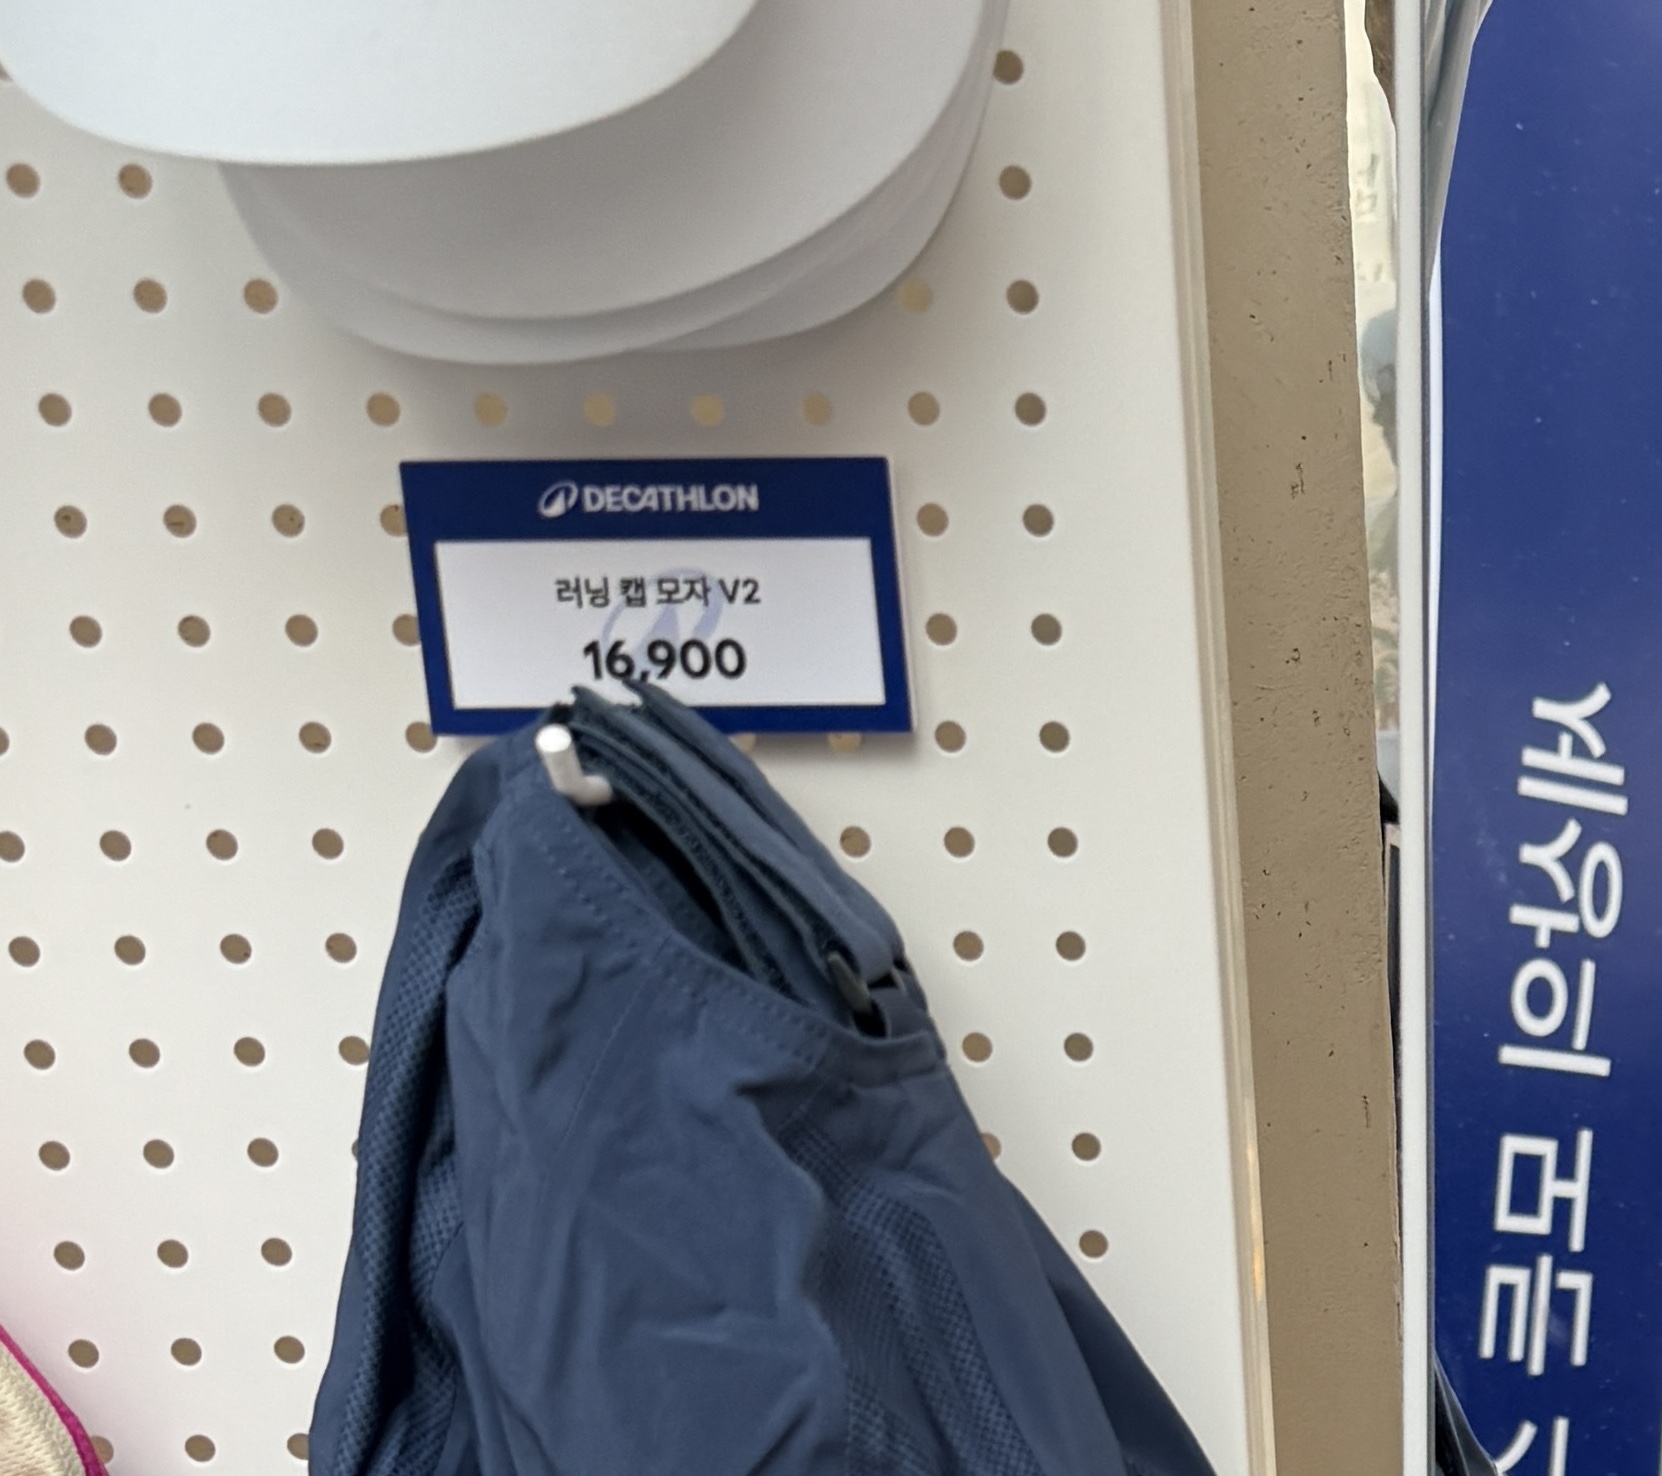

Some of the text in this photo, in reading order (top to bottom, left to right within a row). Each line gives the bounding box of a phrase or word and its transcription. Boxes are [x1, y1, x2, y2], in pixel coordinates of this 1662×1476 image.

[583, 484, 759, 513] DECATHLON
[555, 577, 761, 608] 러닝 캡 모자 V2
[582, 638, 747, 683] 16,900
